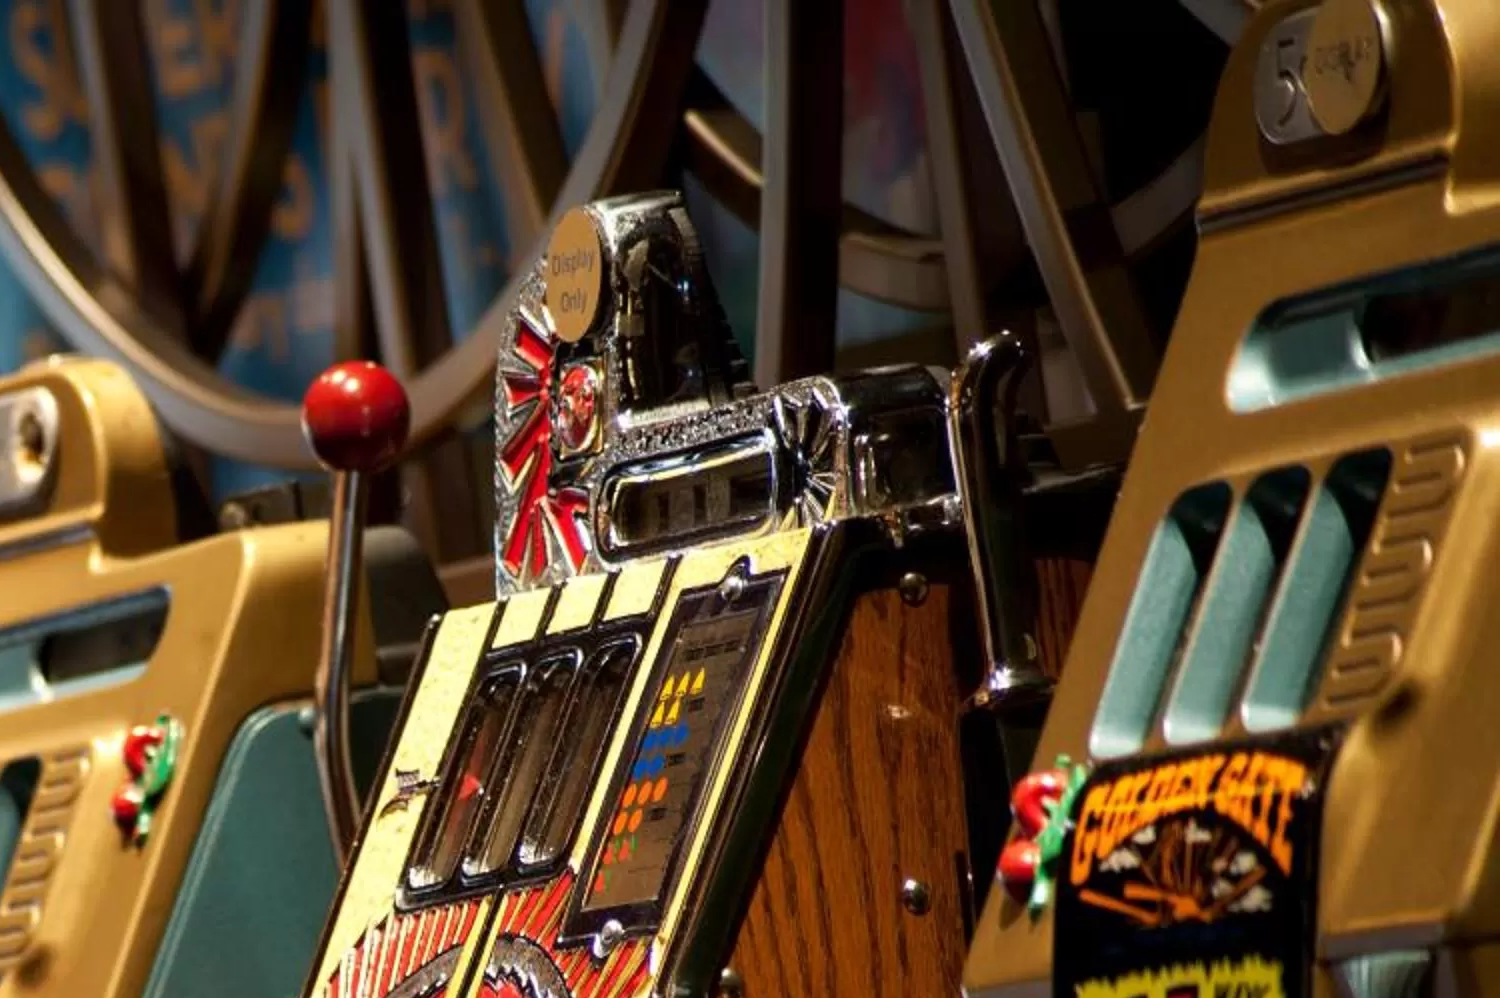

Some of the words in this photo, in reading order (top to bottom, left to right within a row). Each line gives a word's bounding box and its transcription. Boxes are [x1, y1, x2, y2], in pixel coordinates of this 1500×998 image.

[551, 248, 594, 277] Display
[560, 286, 588, 313] Only
[1070, 754, 1226, 886] GOLDEN
[1214, 752, 1306, 877] GATE
